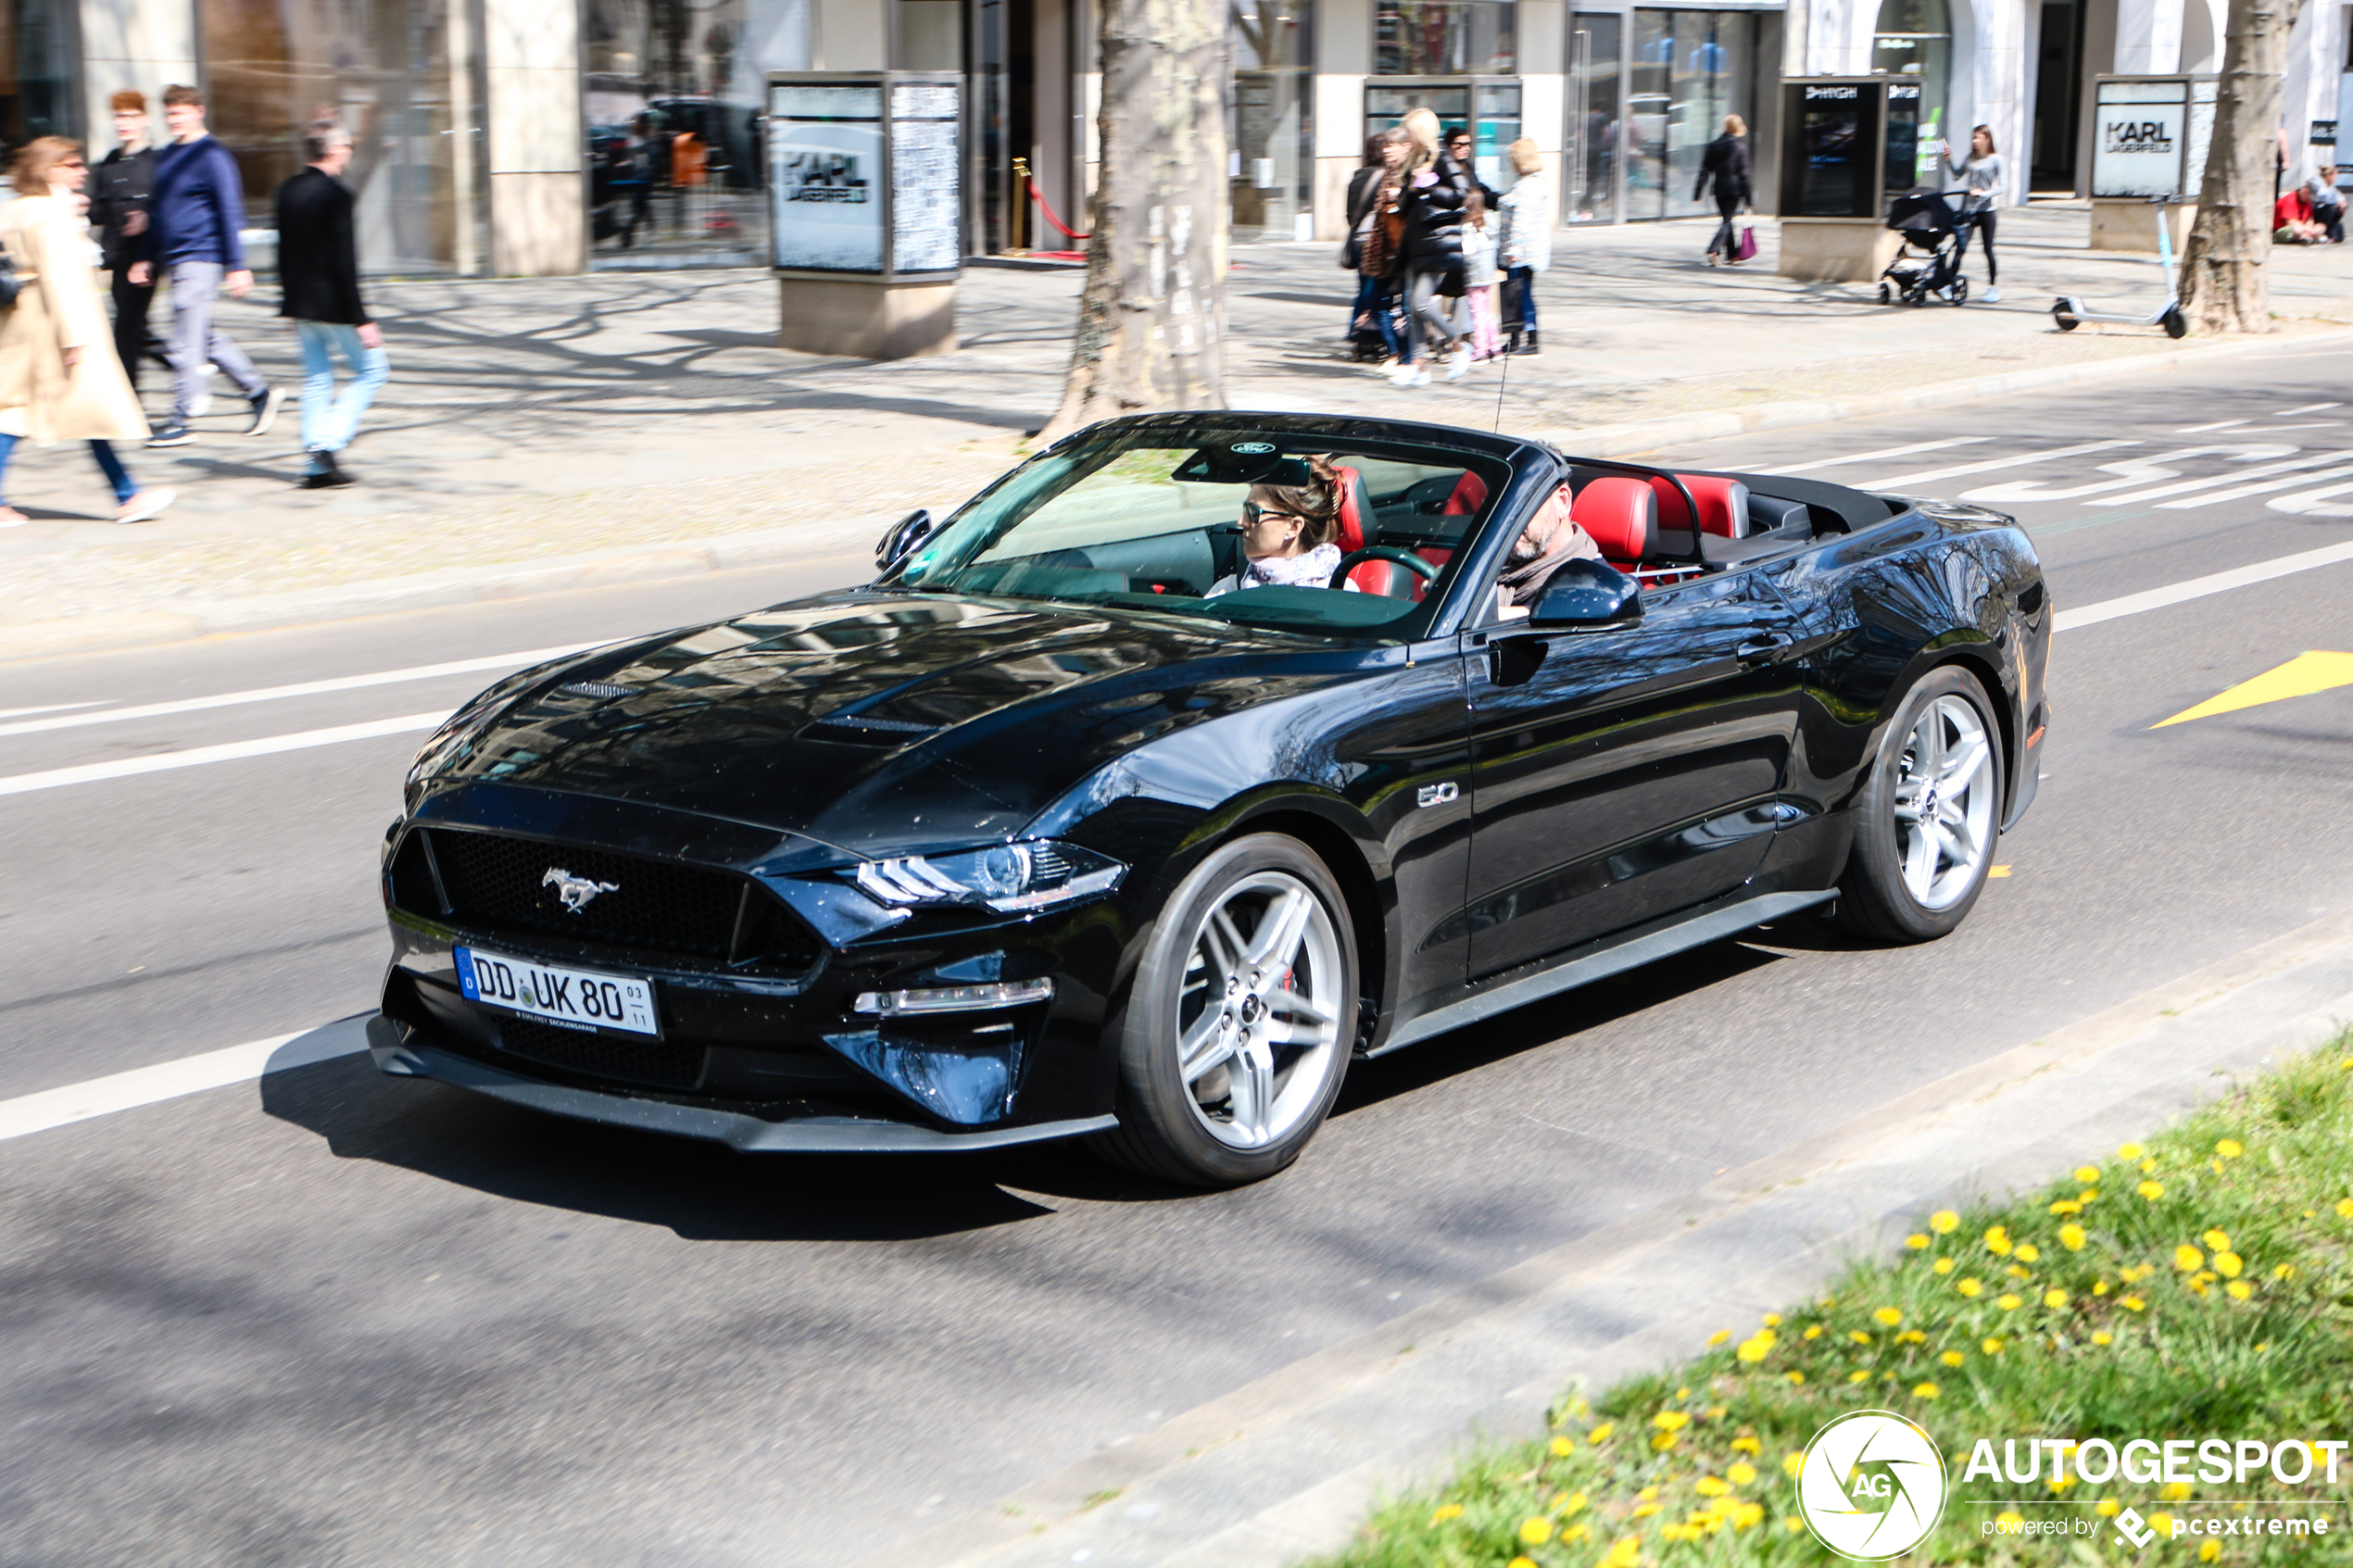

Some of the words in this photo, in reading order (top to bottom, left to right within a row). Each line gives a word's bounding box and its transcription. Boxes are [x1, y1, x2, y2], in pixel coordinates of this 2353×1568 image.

[2106, 122, 2171, 143] KARL
[465, 976, 473, 989] D
[472, 957, 516, 1000] DD
[530, 970, 577, 1014] UK
[580, 979, 623, 1022] 80
